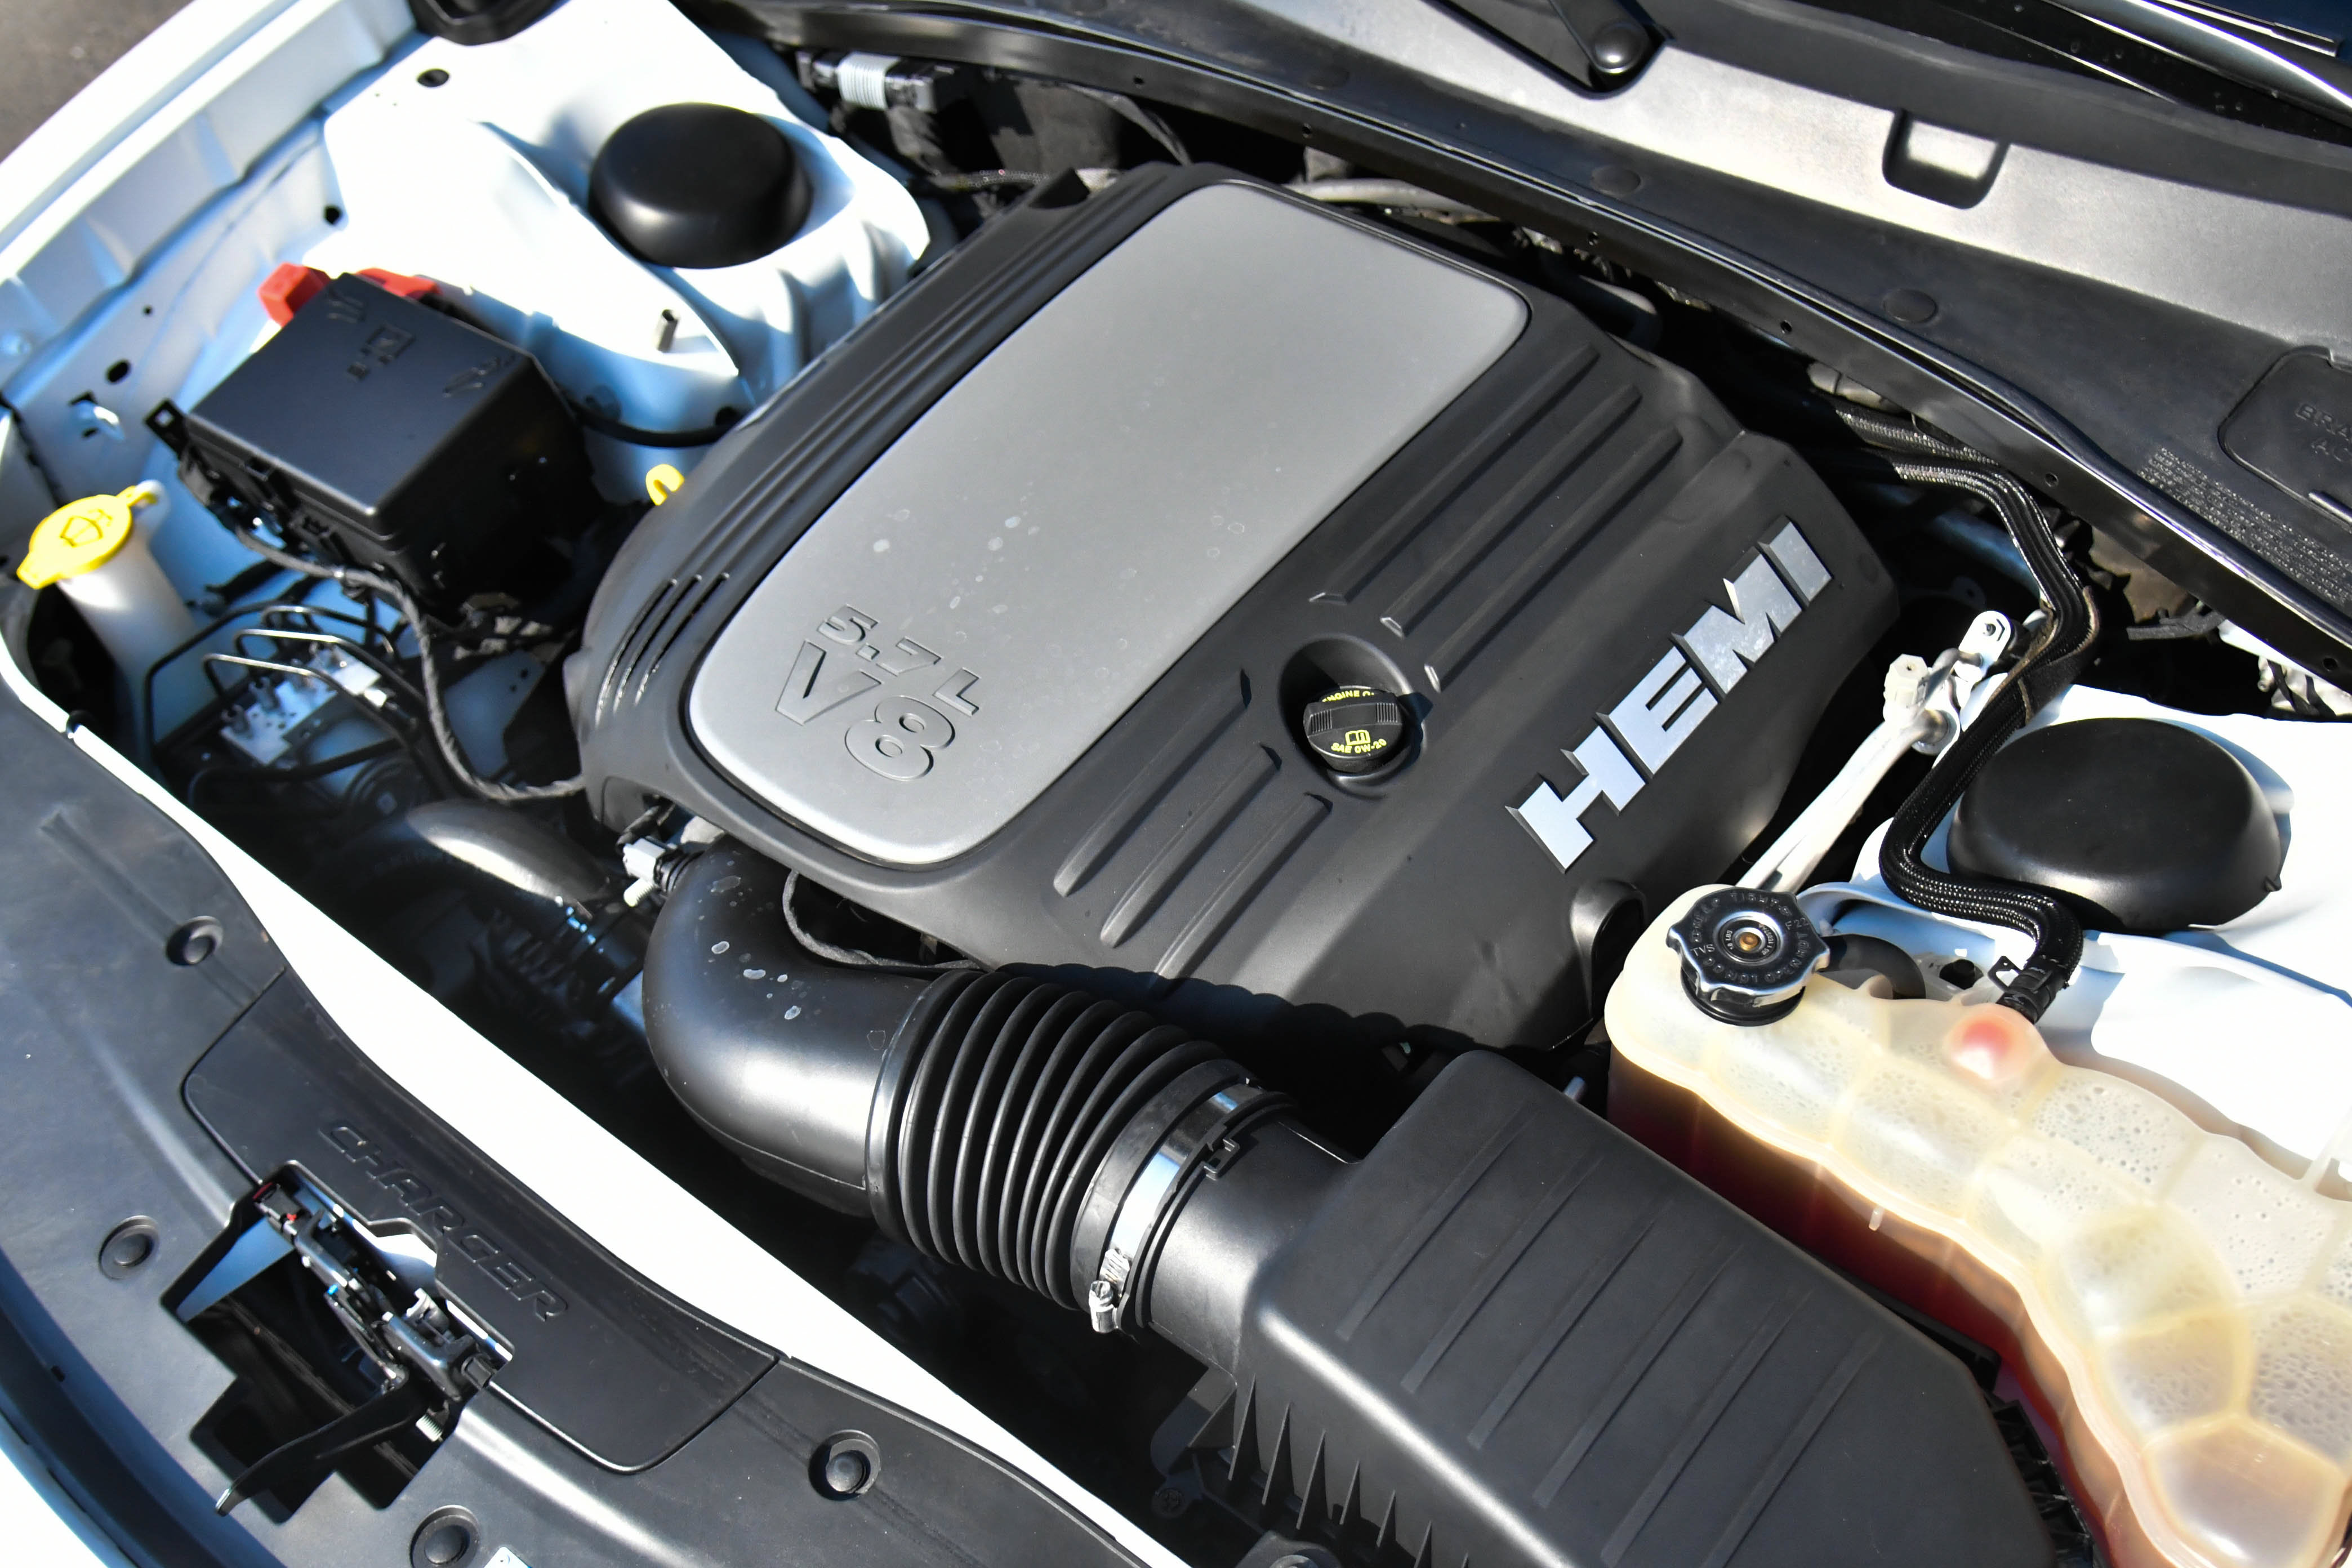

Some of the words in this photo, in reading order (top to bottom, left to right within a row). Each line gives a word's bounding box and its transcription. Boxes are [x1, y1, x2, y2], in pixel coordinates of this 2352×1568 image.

[774, 639, 956, 782] V8
[816, 603, 981, 716] 5.7L
[1505, 515, 1834, 874] HEMI
[1331, 742, 1352, 754] SAE
[1354, 738, 1387, 754] 0W-20
[1690, 943, 1716, 957] TVS
[319, 1124, 568, 1322] CHARGER
